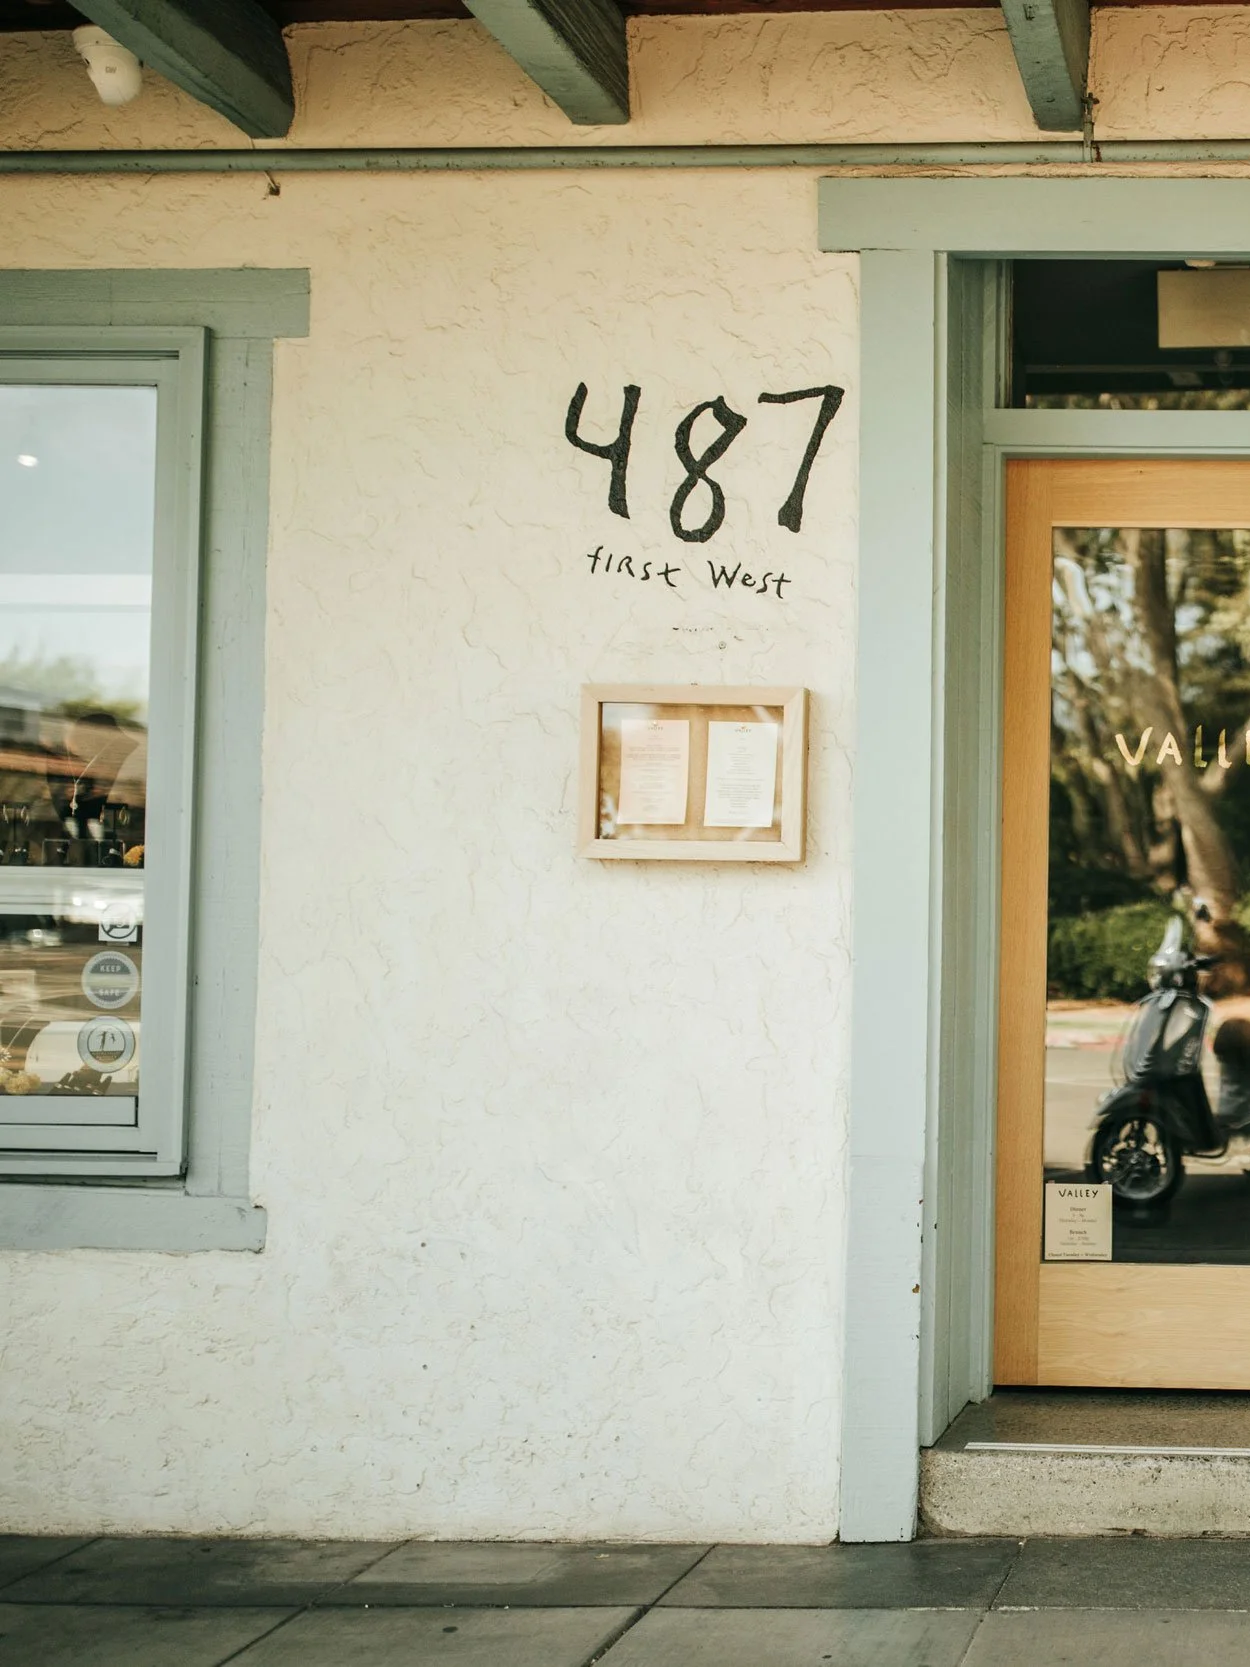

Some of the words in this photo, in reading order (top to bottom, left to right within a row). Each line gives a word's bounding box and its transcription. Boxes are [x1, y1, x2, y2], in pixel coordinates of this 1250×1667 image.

[565, 382, 845, 543] 487
[706, 560, 792, 599] West
[1058, 1188, 1099, 1198] VALLEY
